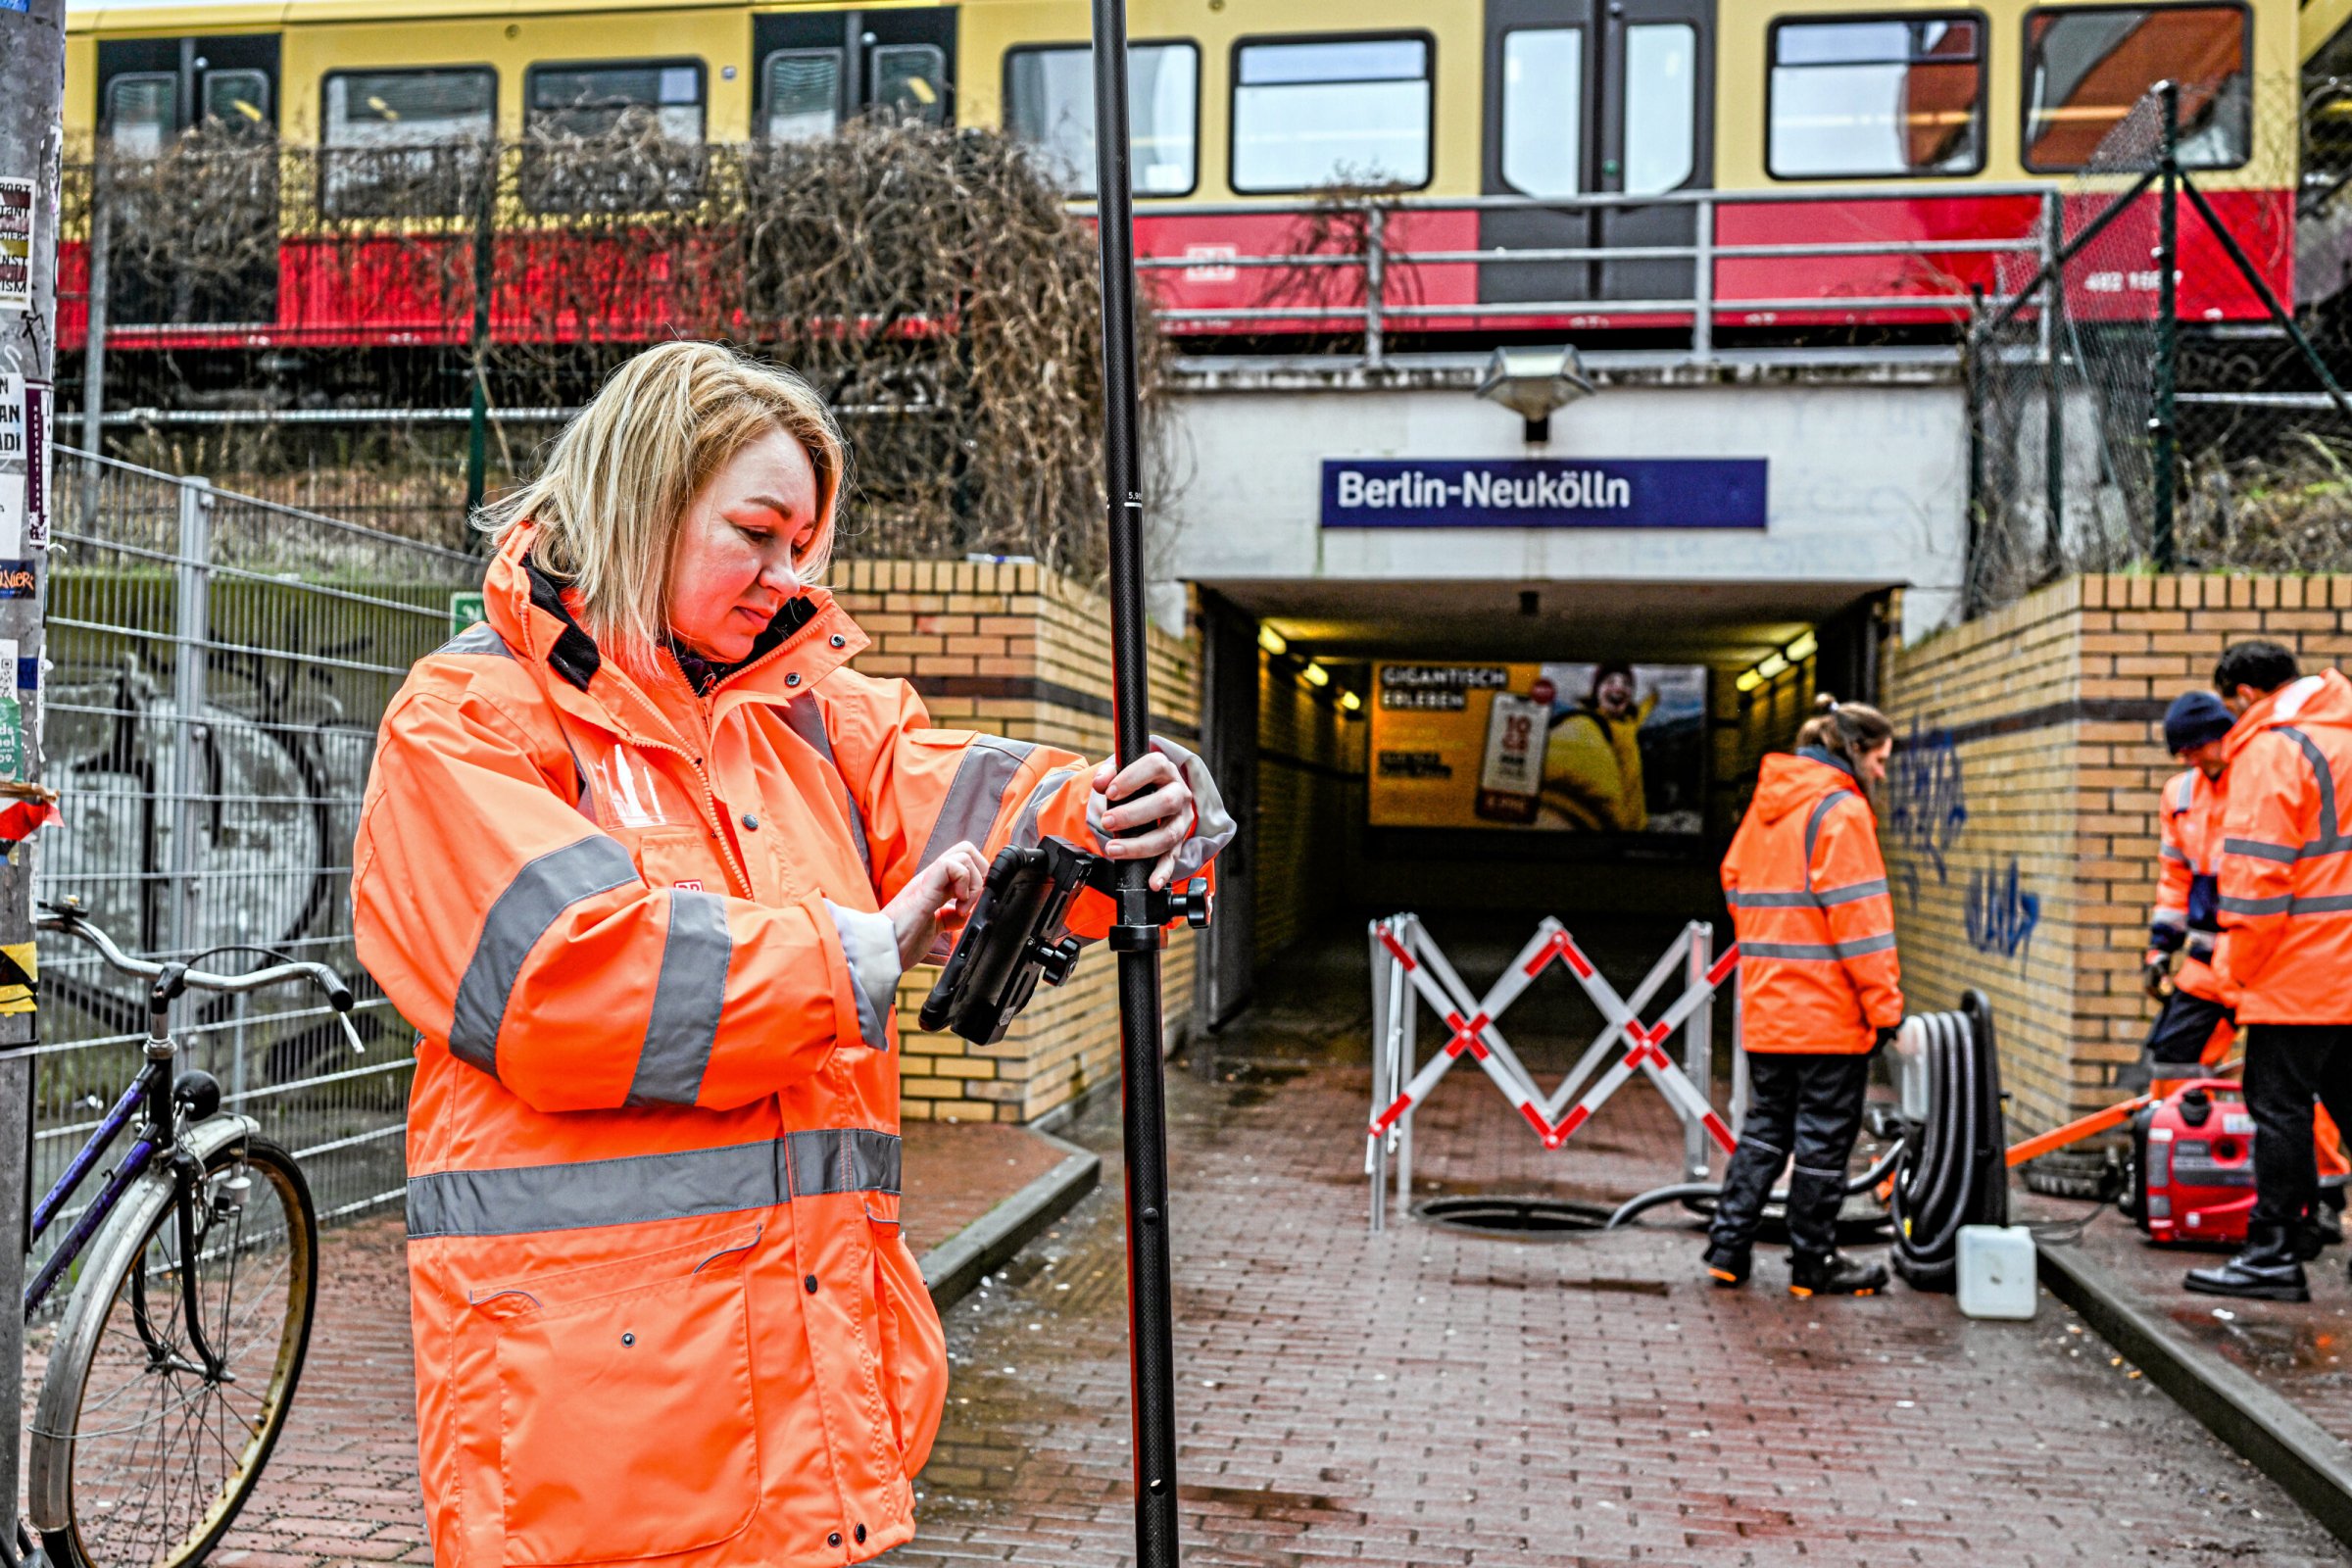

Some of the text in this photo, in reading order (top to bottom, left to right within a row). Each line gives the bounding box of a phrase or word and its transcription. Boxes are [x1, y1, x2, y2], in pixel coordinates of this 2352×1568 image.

[0, 280, 26, 293] ISM
[1338, 470, 1630, 509] Berlin-Neukölln
[1382, 668, 1507, 685] GIGANTISCH
[1383, 692, 1464, 708] ERLEBEN
